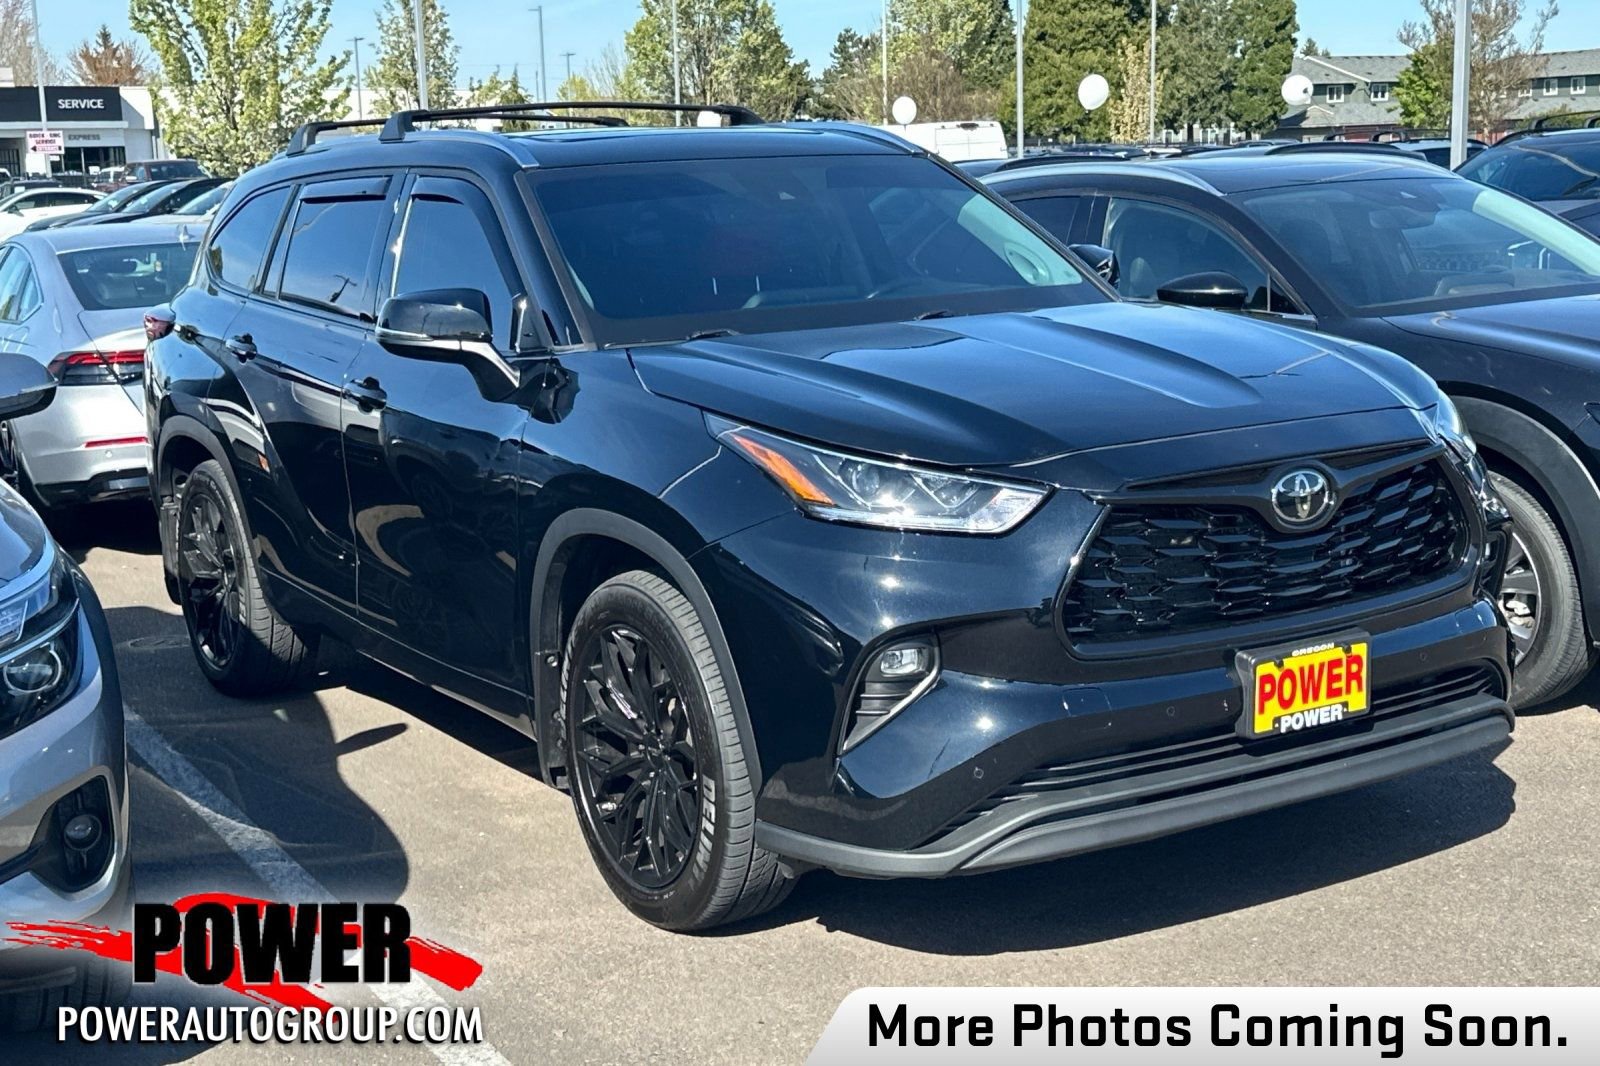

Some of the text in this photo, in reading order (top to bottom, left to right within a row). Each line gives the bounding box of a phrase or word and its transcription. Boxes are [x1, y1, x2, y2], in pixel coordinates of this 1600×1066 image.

[58, 98, 104, 109] SERVICE
[1291, 642, 1335, 656] OREGON
[1258, 653, 1364, 715] POWER
[1280, 703, 1343, 733] POWER
